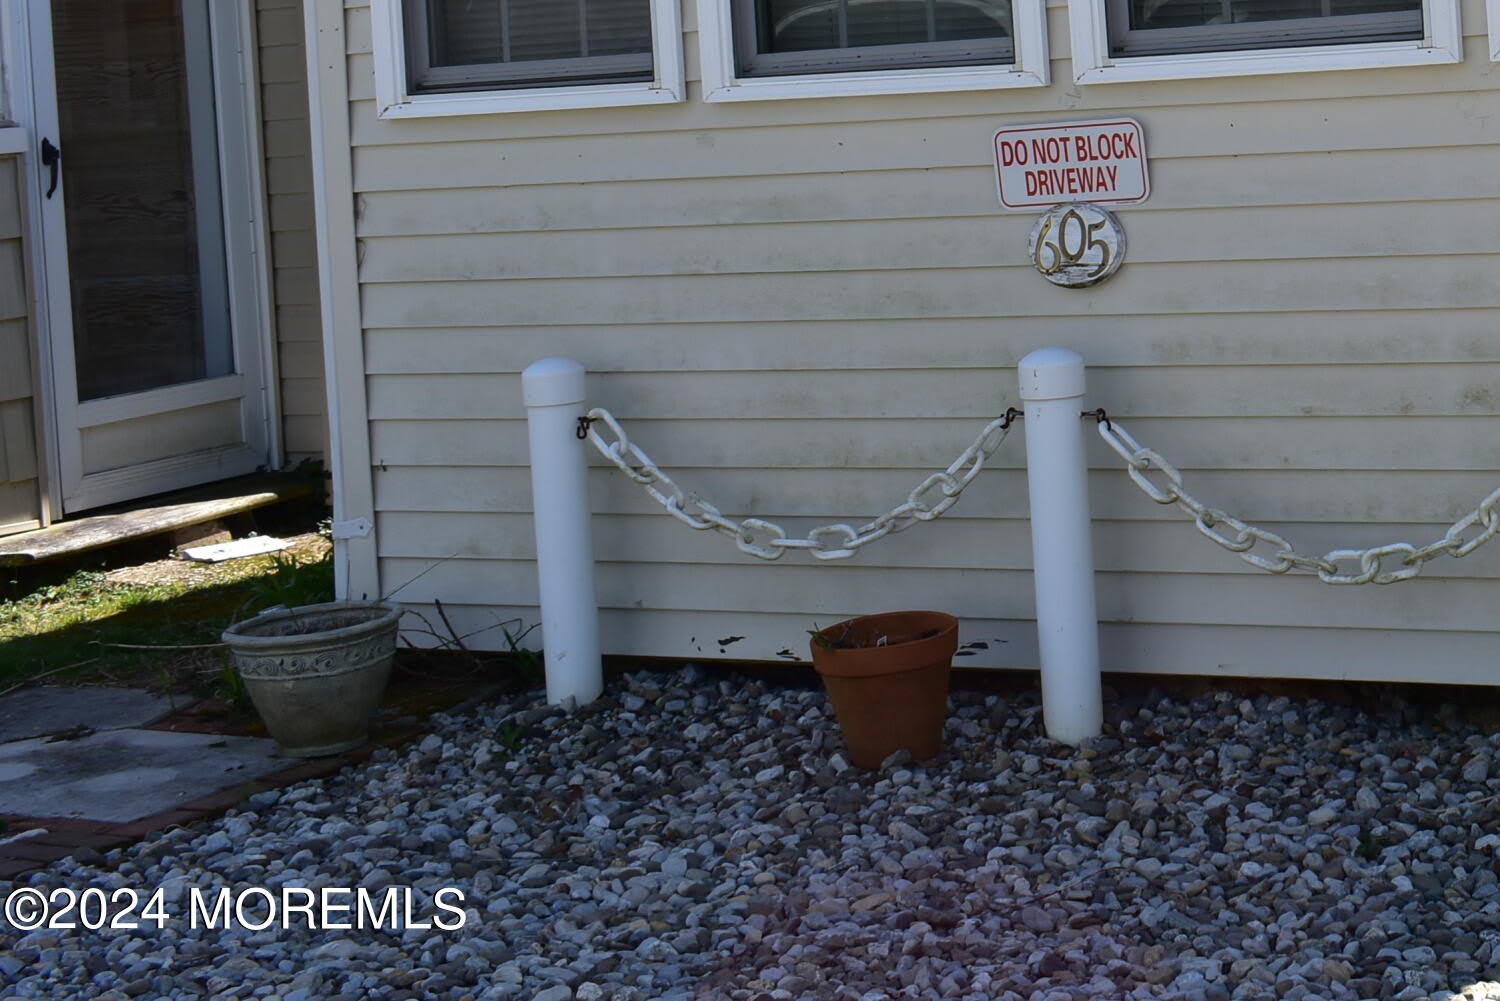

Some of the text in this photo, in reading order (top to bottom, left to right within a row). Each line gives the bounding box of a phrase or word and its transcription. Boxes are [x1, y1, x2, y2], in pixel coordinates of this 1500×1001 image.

[1001, 132, 1137, 166] DO NOT BLOCK
[1024, 165, 1118, 197] DRIVEWAY
[1035, 209, 1110, 277] 605
